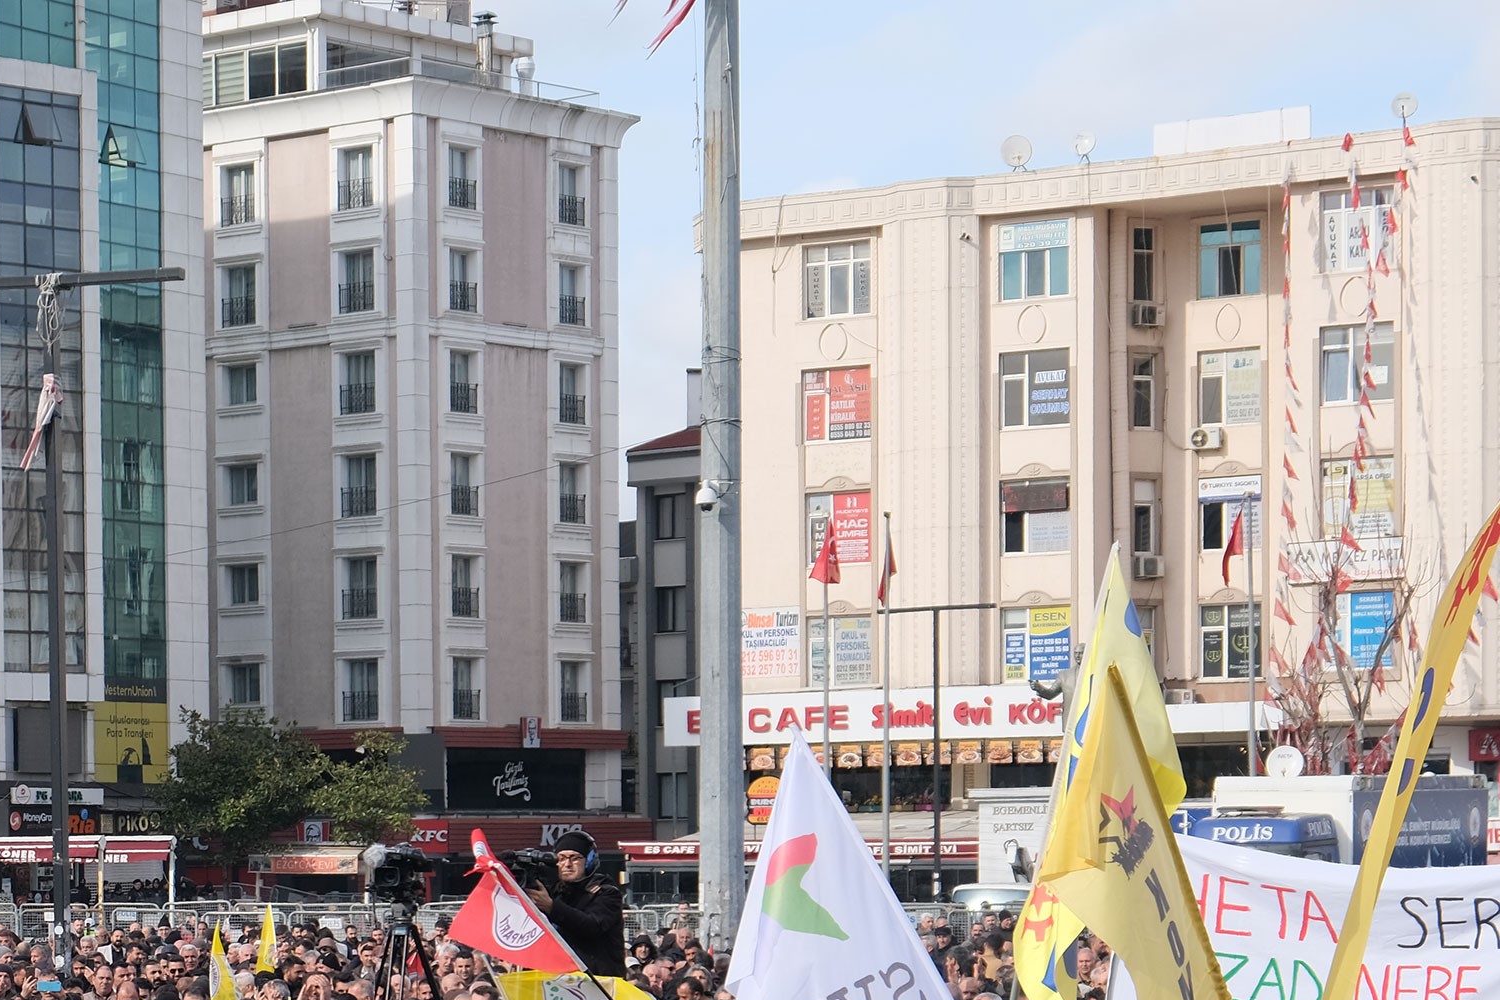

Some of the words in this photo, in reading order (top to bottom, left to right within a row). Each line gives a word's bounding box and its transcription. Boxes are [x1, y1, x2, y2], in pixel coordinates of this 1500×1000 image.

[1329, 216, 1337, 268] AVUKAT
[837, 518, 869, 528] HAC
[837, 529, 869, 538] UMRE
[776, 611, 799, 627] Turizm
[1034, 612, 1067, 622] ESEN
[742, 629, 754, 639] KUL
[764, 627, 798, 637] PERSONEL
[841, 631, 858, 640] OKUL
[836, 641, 870, 650] PERSONEL
[742, 650, 756, 662] 212
[776, 649, 785, 660] 97
[789, 648, 798, 660] 31
[742, 665, 756, 676] 532
[759, 664, 773, 675] 257
[776, 663, 785, 674] 70
[789, 663, 799, 674] 37
[872, 700, 936, 729] Simit
[953, 696, 992, 726] Evi
[1009, 697, 1063, 725] KÖF
[109, 715, 150, 726] Uluslararası
[687, 709, 700, 734] E
[748, 704, 850, 734] CAFE
[106, 728, 122, 738] Para
[124, 728, 153, 738] Transferi
[993, 804, 1048, 816] EGEMENLİ
[993, 822, 1034, 833] ŞARTSIZ
[1212, 822, 1274, 842] POLİS
[411, 829, 448, 843] KFC
[645, 845, 661, 854] ES
[663, 845, 695, 854] CAFE
[894, 844, 931, 854] SİMİT
